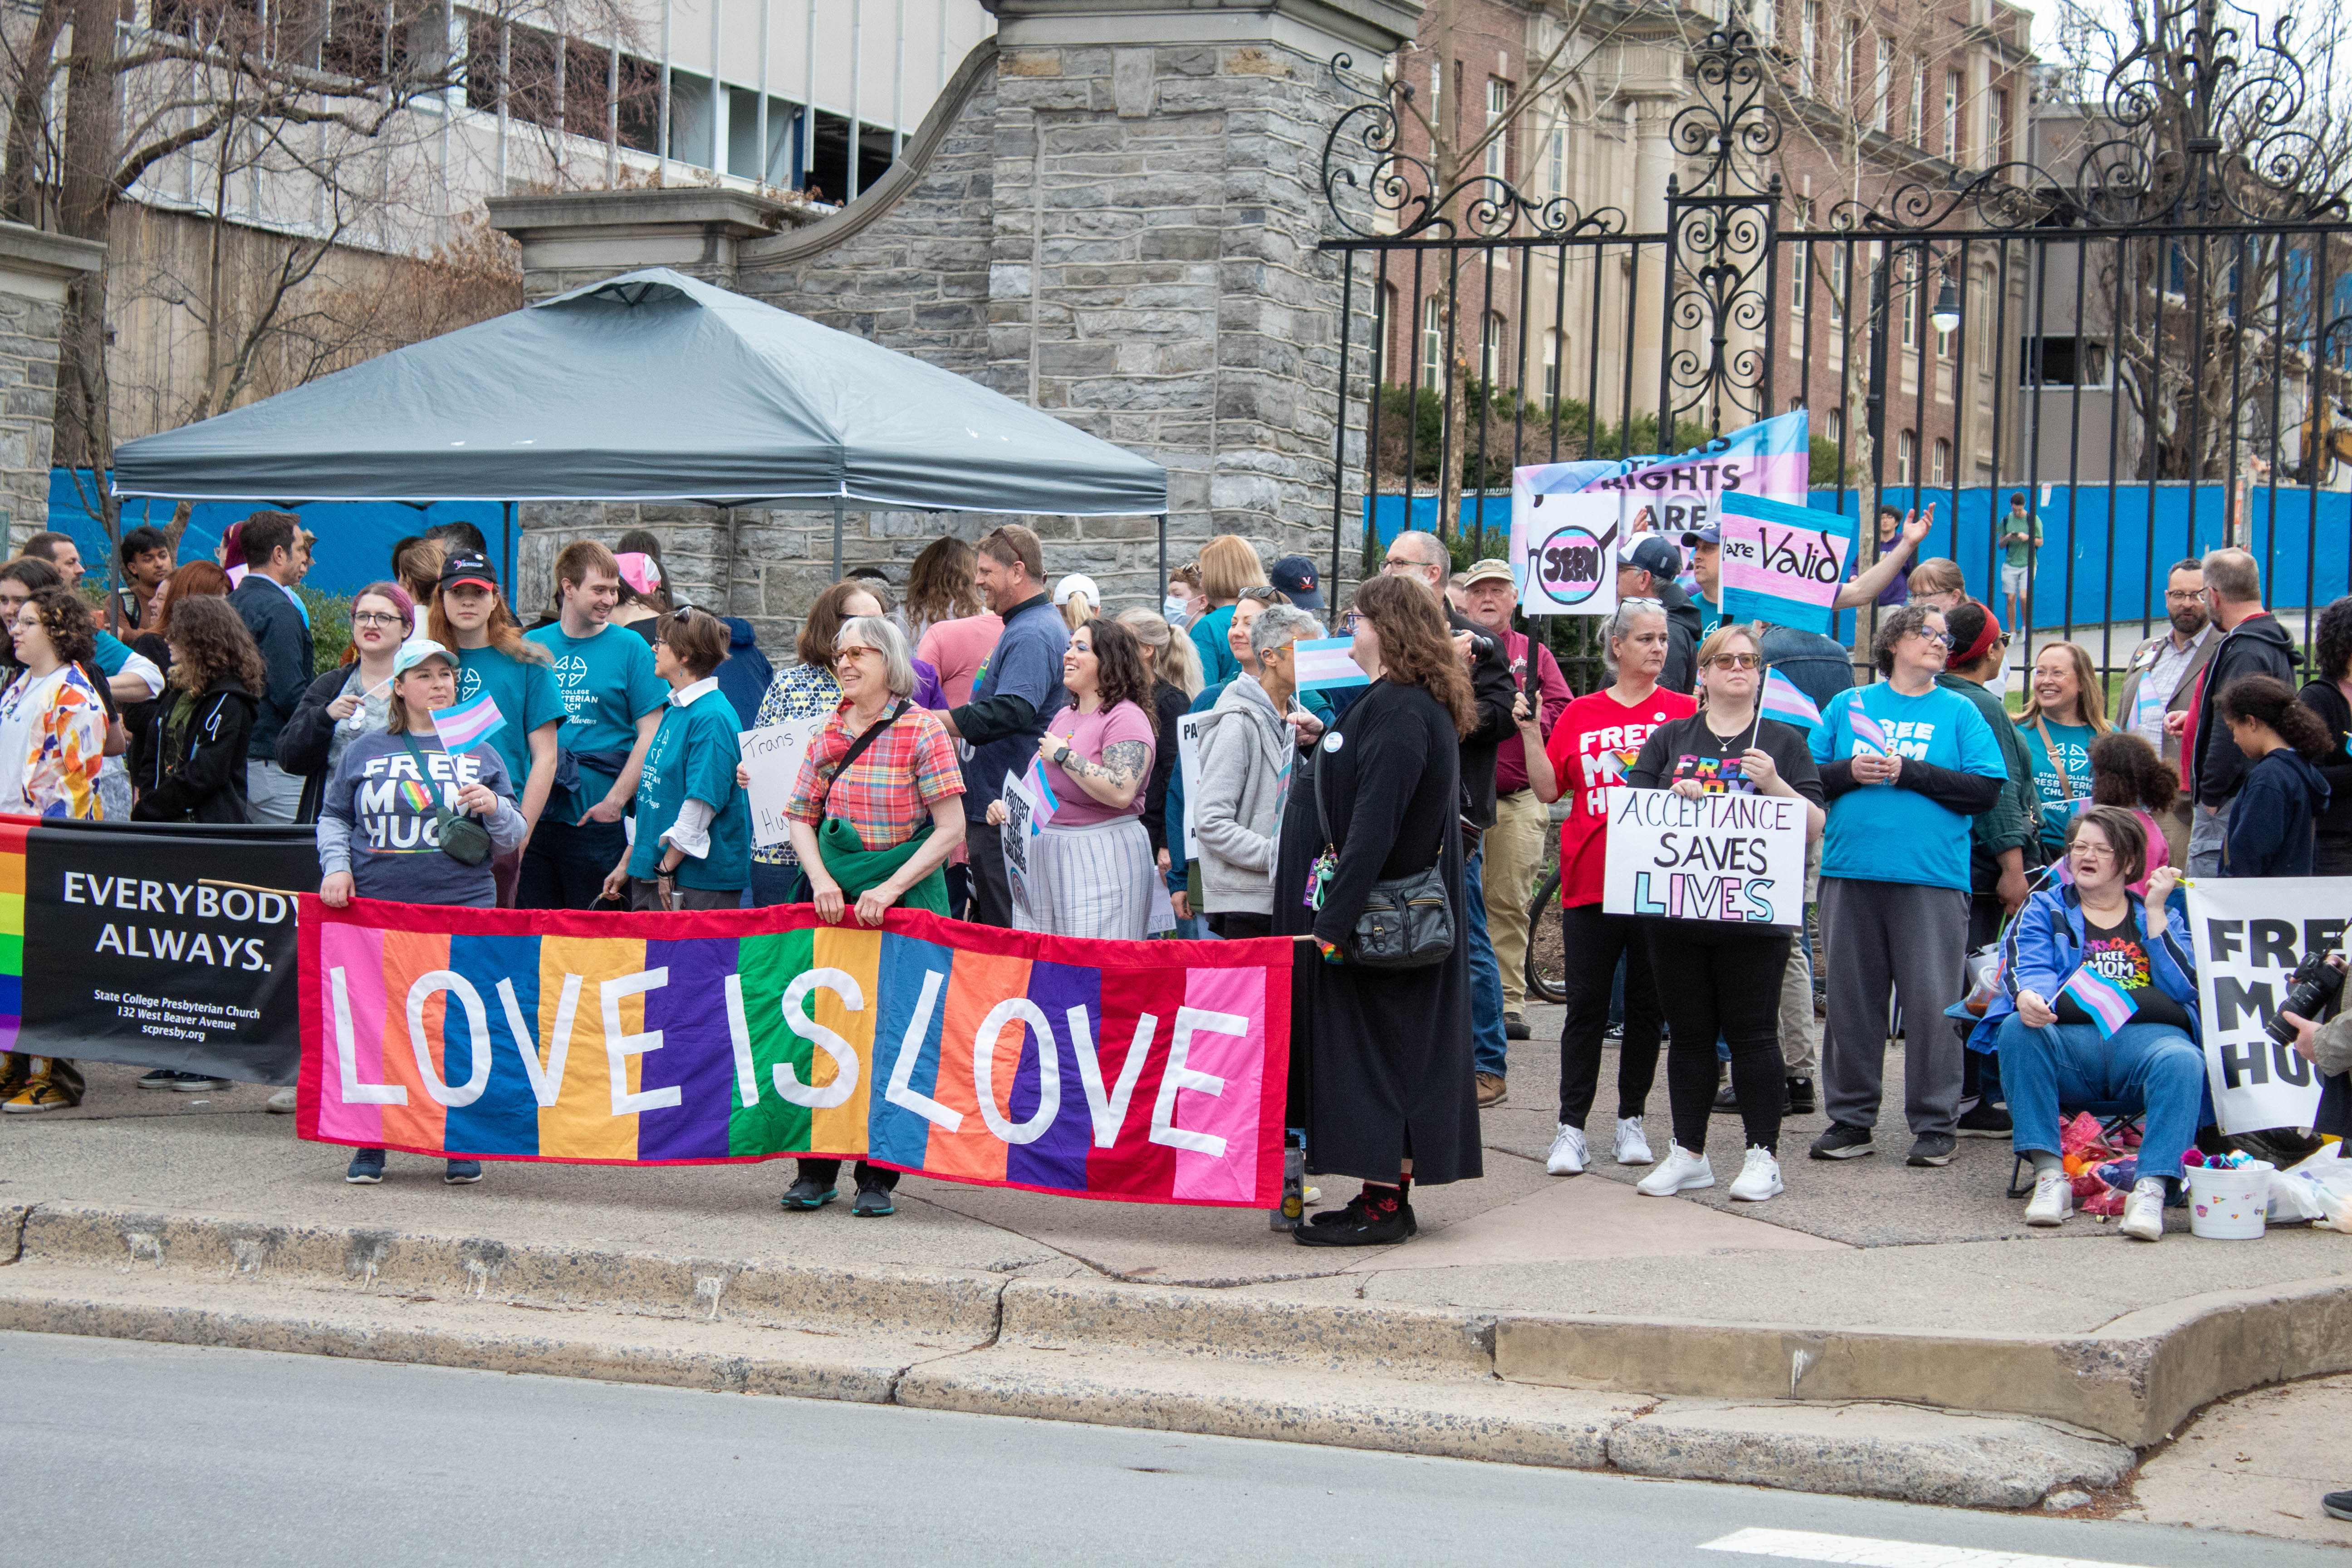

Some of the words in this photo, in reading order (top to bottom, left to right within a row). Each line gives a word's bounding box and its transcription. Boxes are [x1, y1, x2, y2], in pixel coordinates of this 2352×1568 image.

[1642, 505, 1707, 530] ARE
[1726, 543, 1754, 558] are
[1759, 527, 1840, 583] Valid
[742, 733, 794, 758] Trans
[362, 754, 481, 784] FREE
[1005, 785, 1030, 823] PROTECT
[1617, 791, 1793, 830] ACCEPTANCE
[1007, 823, 1024, 853] TRANS
[1654, 832, 1768, 876] SAVES
[1634, 871, 1775, 923] LIVES
[95, 923, 272, 972] ALWAYS.
[2095, 951, 2126, 961] FREE
[2087, 960, 2134, 977] MOM
[93, 989, 120, 1002] State
[122, 992, 159, 1008] College
[162, 997, 223, 1014] Presbyterian
[225, 1005, 261, 1019] Church
[117, 1005, 135, 1018] 132
[137, 1008, 162, 1021] West
[163, 1011, 196, 1025] Beaver
[199, 1016, 236, 1030] Avenue
[142, 1024, 206, 1042] scpresby.org
[329, 965, 681, 1117] LOVE
[725, 967, 865, 1109] IS
[885, 968, 1249, 1158] LOVE
[2220, 1042, 2325, 1090] HU
